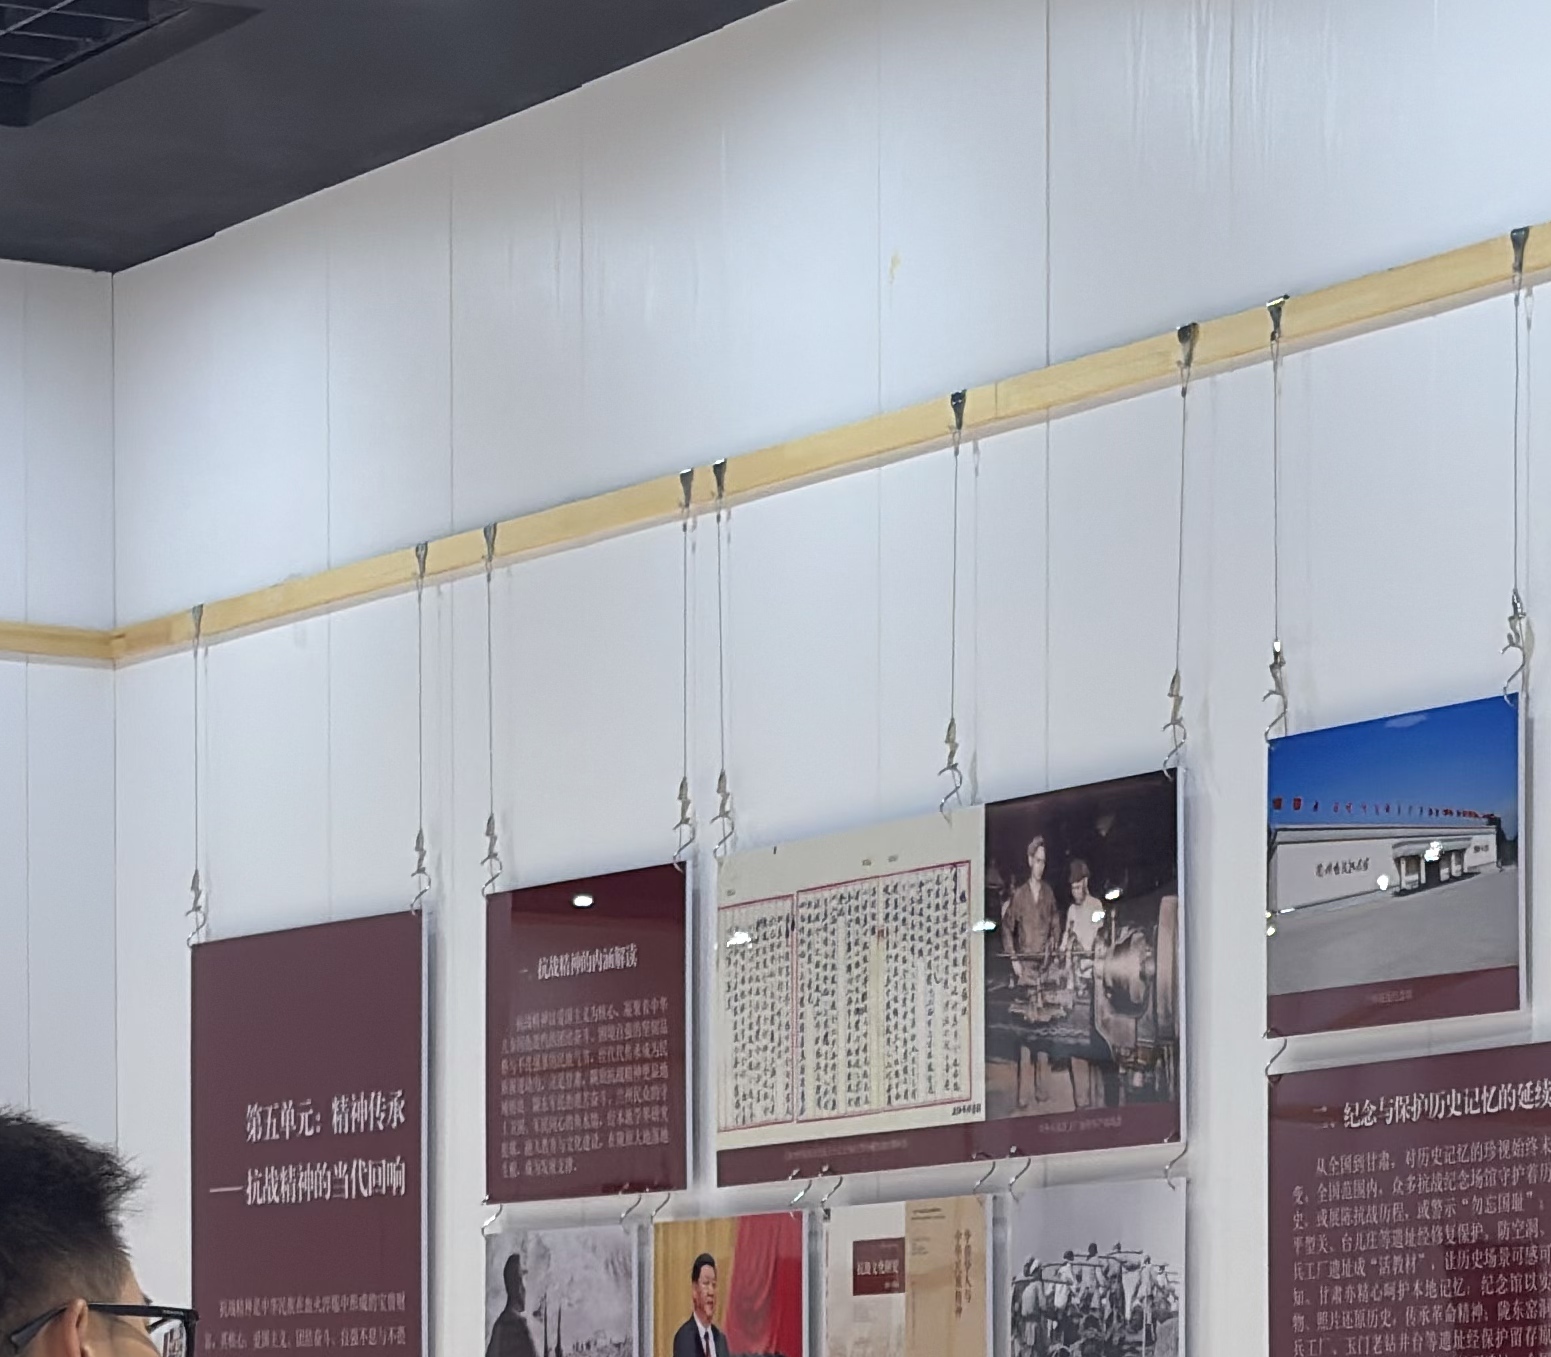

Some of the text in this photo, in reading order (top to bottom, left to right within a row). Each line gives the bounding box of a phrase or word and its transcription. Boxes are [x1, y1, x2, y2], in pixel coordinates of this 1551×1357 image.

[246, 1089, 406, 1142] 第五单元：精神传承
